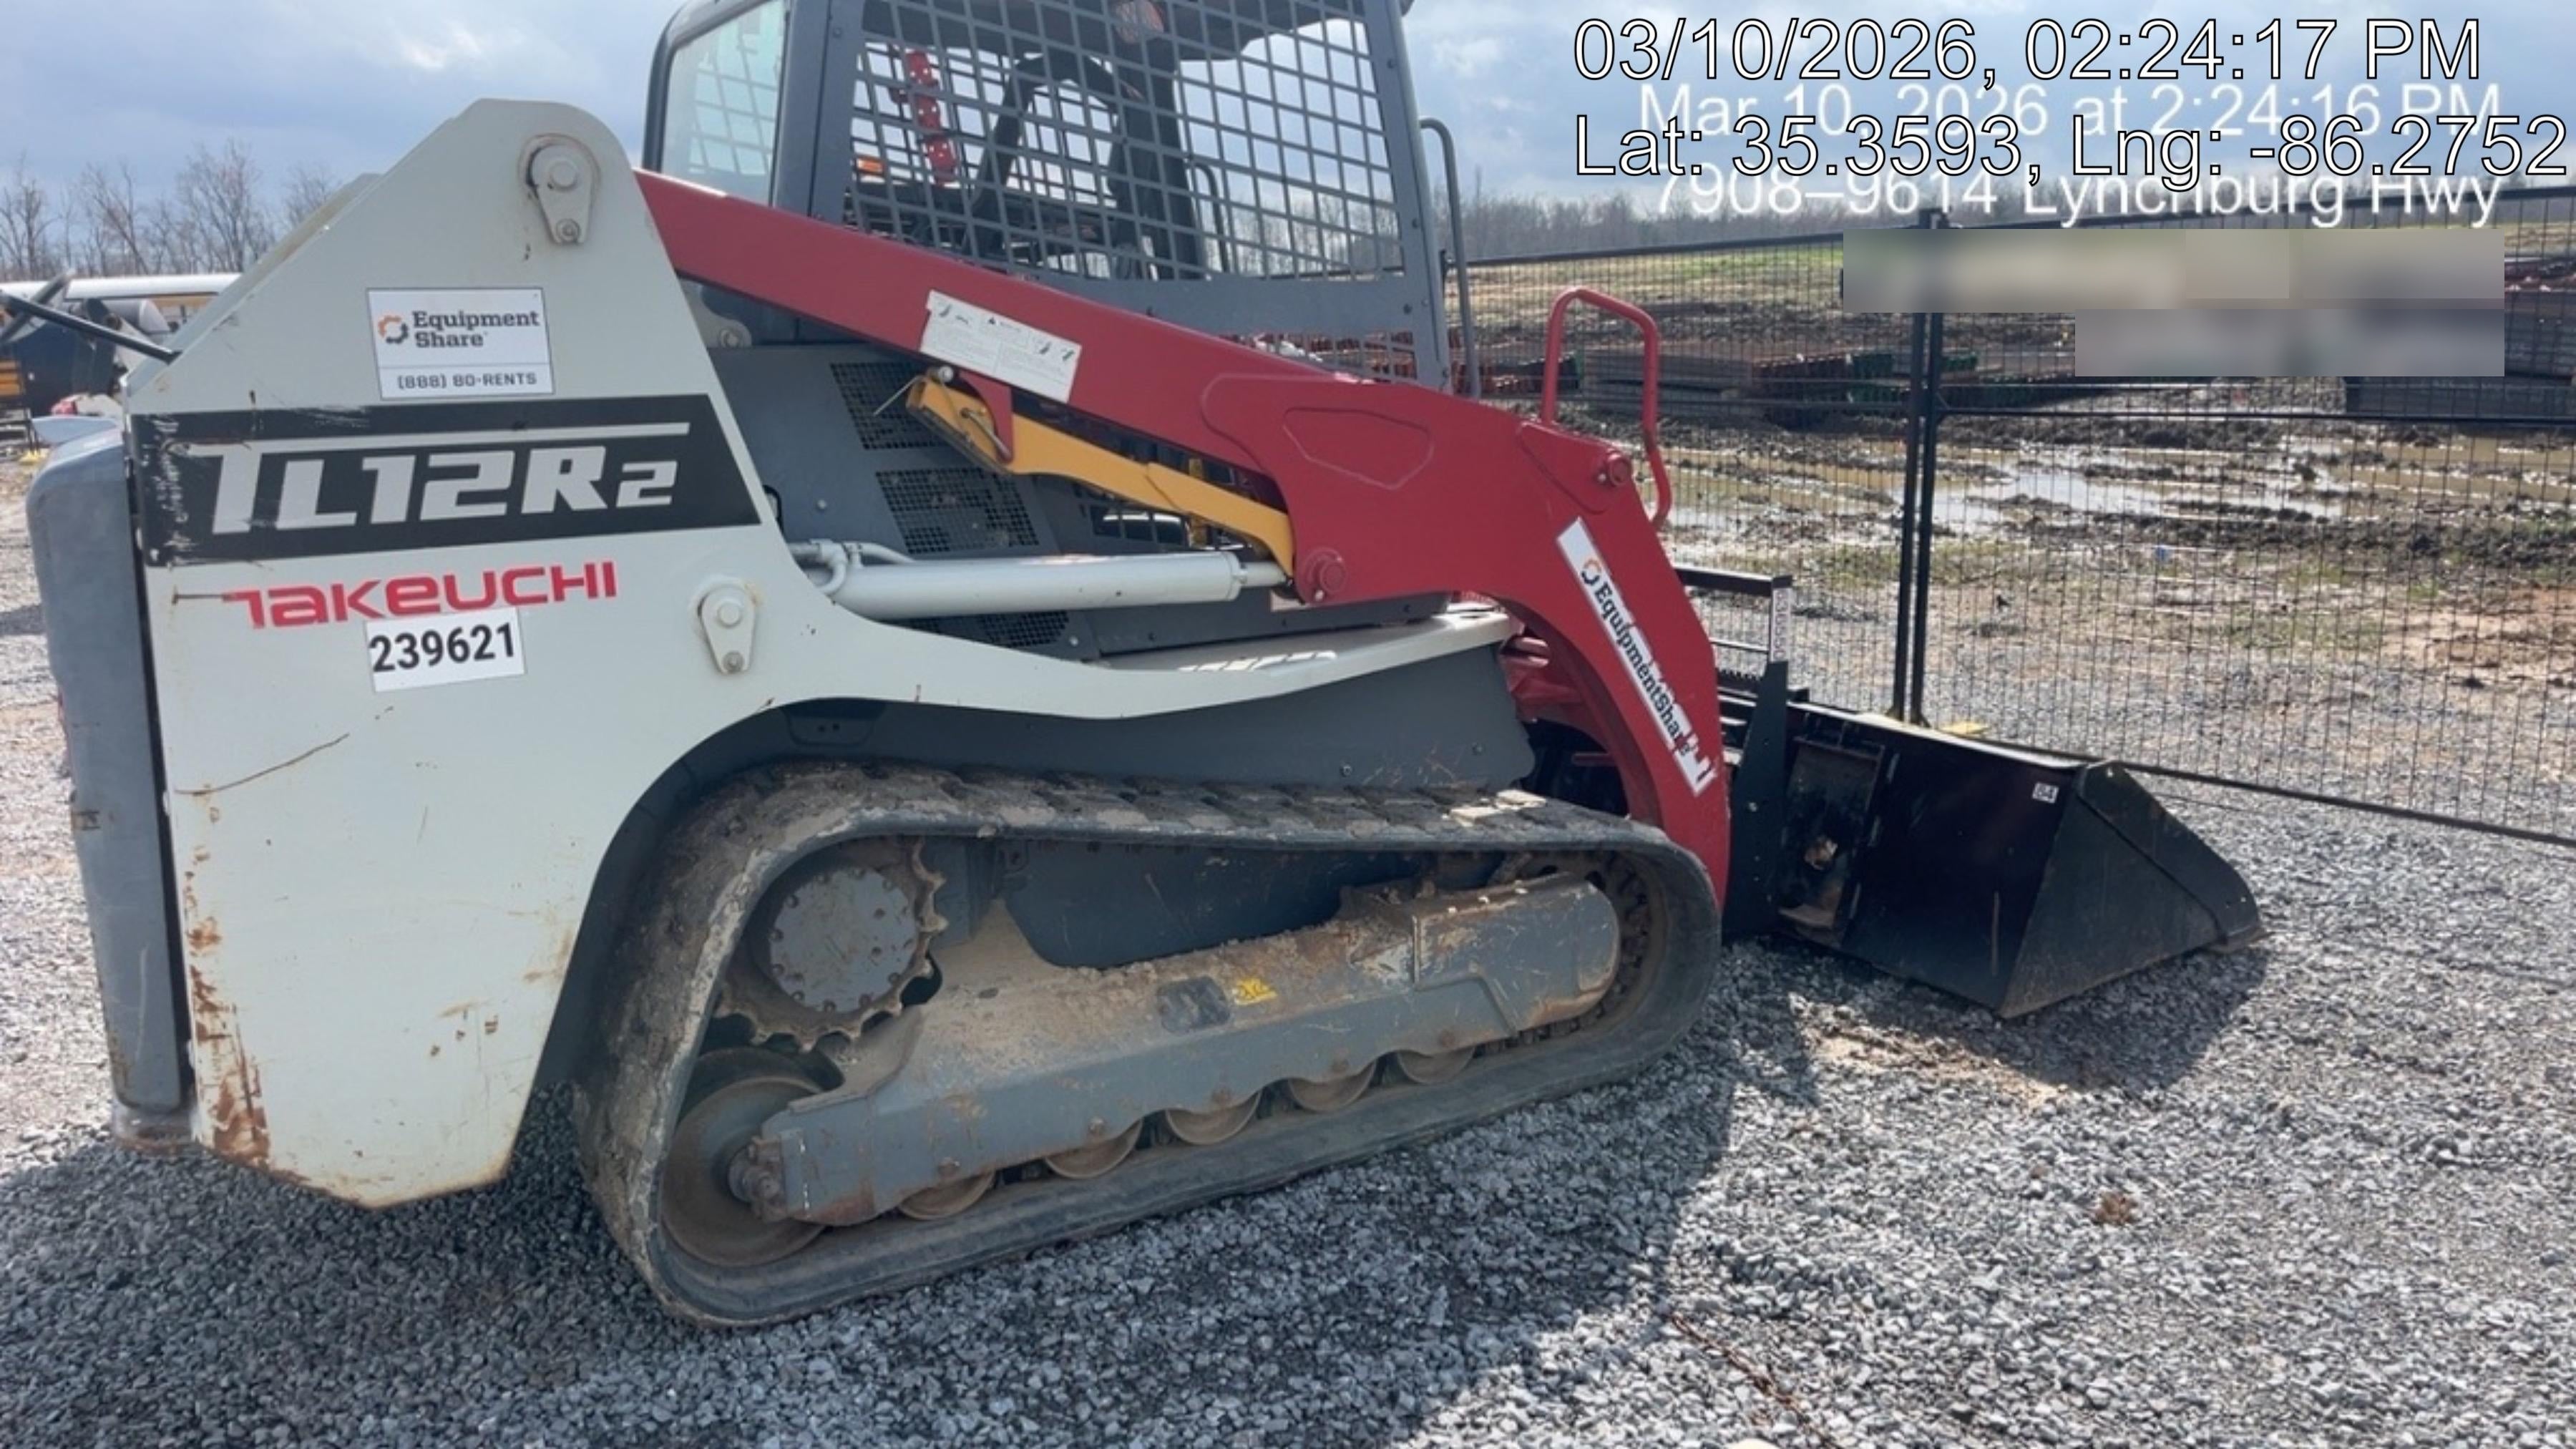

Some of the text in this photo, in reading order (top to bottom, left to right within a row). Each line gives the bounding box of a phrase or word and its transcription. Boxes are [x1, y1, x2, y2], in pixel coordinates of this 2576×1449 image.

[411, 310, 541, 332] Equipment
[415, 331, 484, 348] Share
[397, 374, 447, 389] (888)
[187, 422, 690, 535] TL12R2
[369, 622, 515, 673] 239621
[1594, 581, 1695, 756] EquipmentShae
